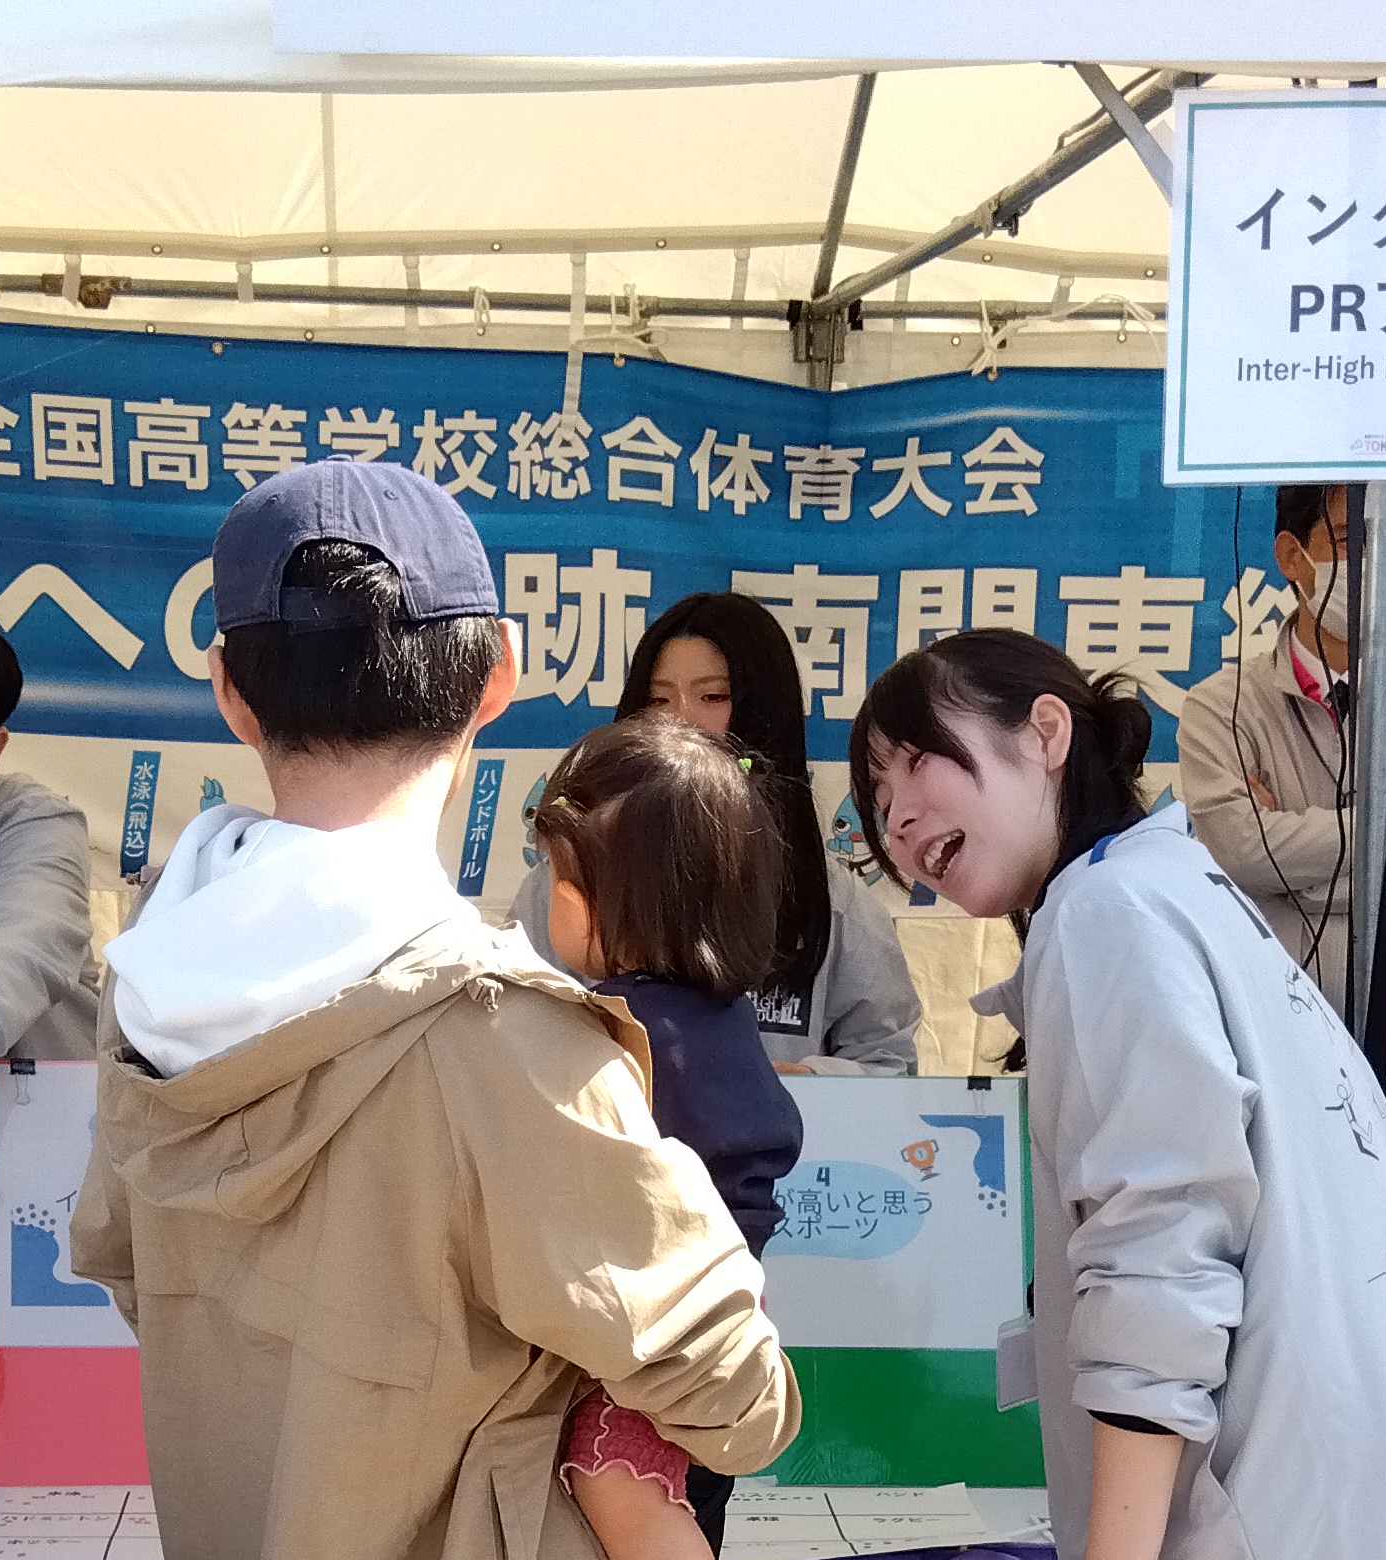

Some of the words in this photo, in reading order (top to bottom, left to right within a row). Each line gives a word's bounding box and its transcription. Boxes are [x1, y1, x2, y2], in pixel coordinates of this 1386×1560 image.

[1236, 354, 1376, 386] Inter-High
[461, 769, 497, 880] ハンドボール
[816, 1166, 830, 1187] 4
